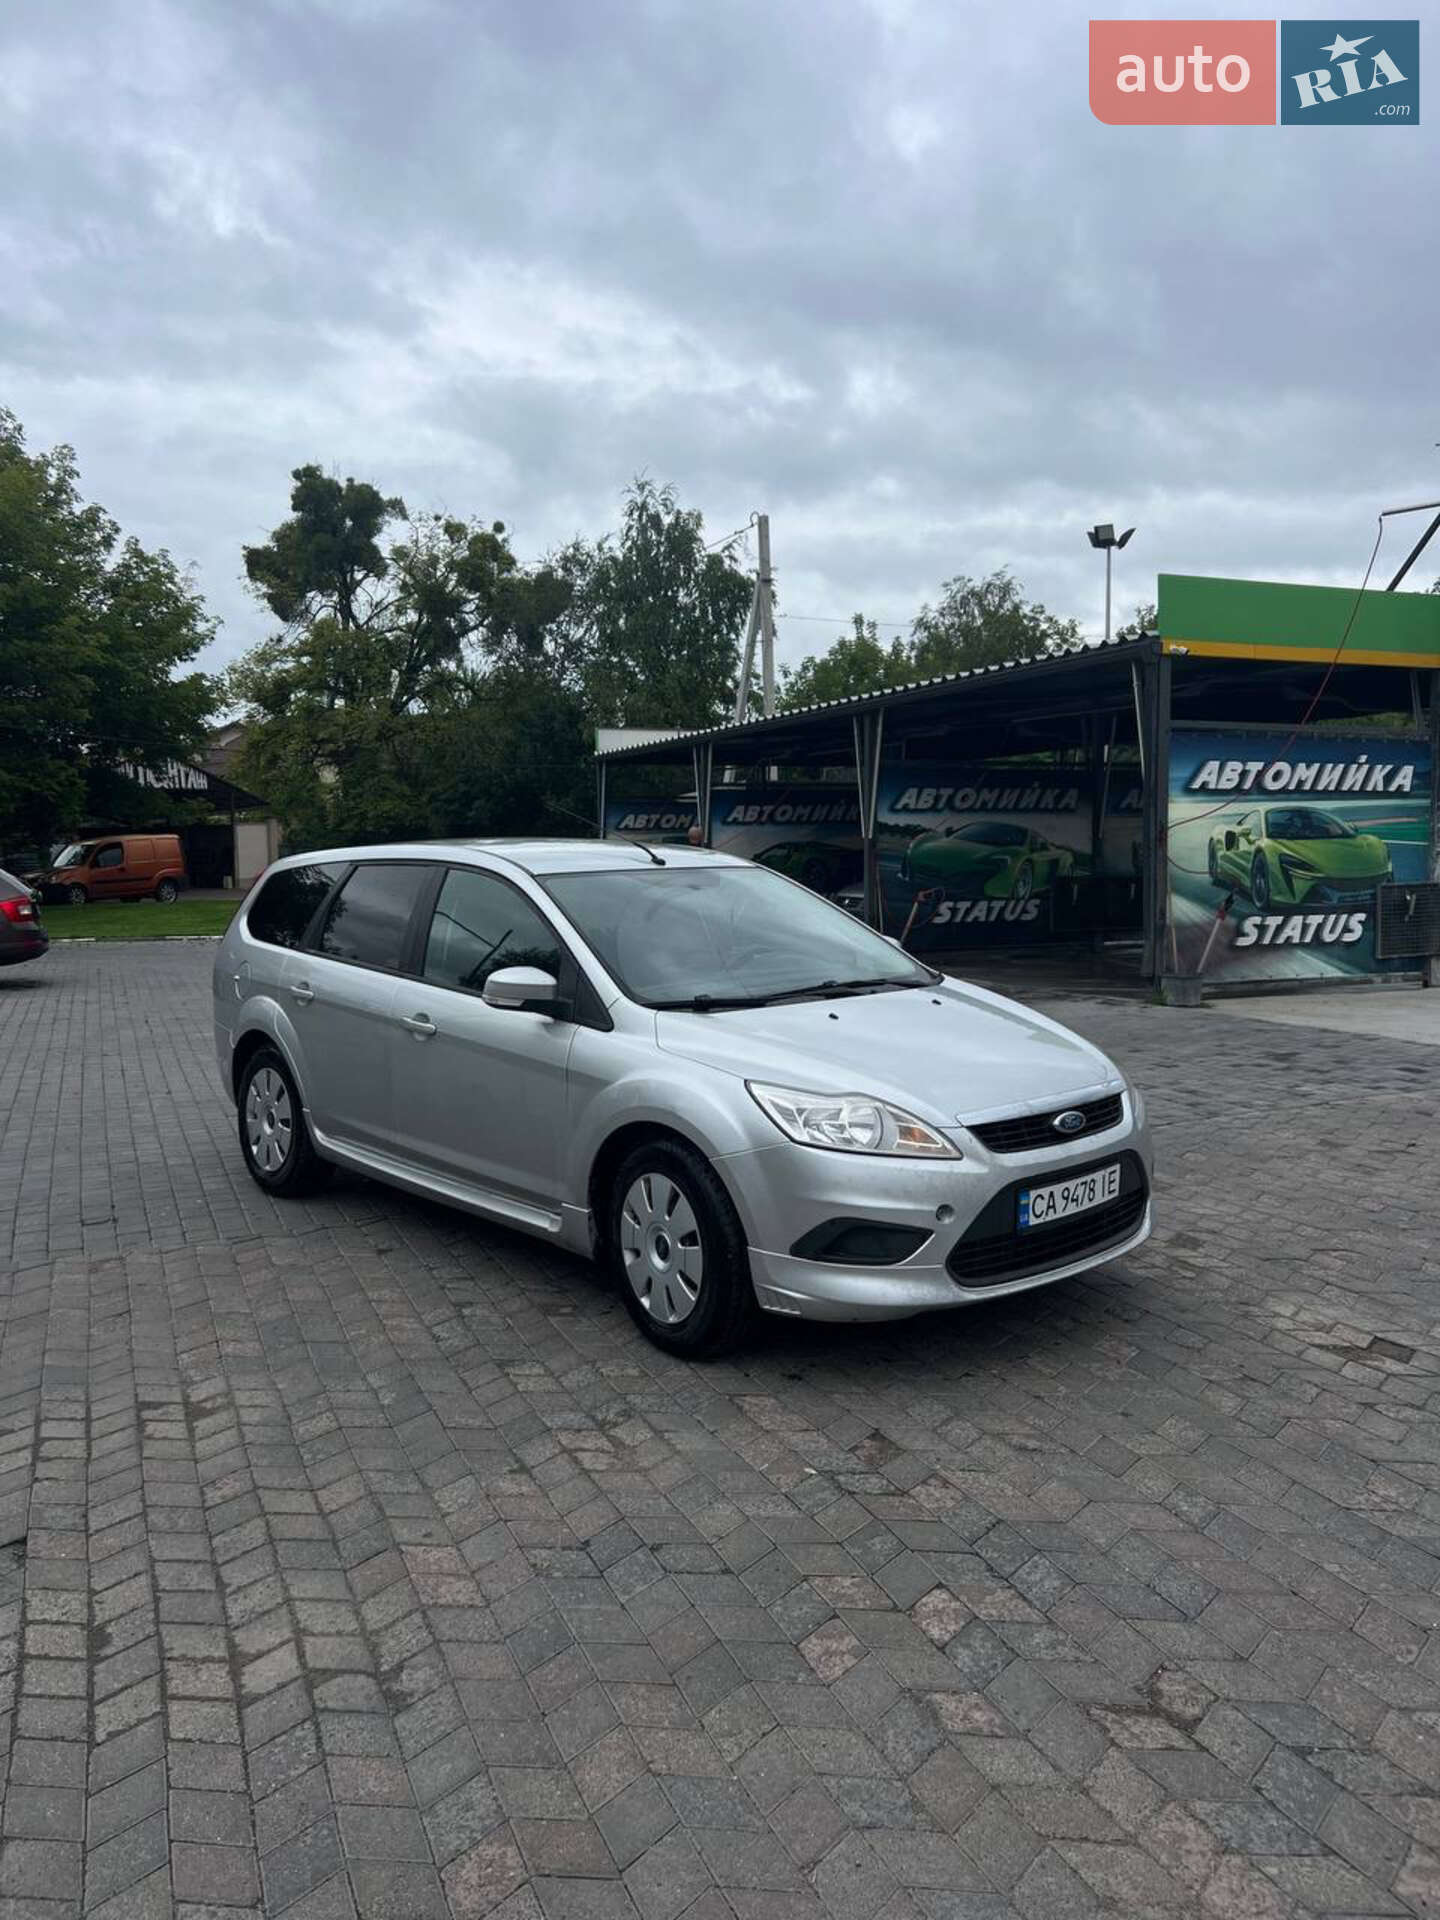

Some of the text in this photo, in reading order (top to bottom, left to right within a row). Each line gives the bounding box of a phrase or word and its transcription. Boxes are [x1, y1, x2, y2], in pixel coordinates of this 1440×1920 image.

[1190, 755, 1414, 792] АВТОМИЙКА
[894, 782, 1079, 810] АВТОМИЙКА
[932, 898, 1041, 924] STATUS
[1236, 912, 1367, 946] STATUS
[1031, 1169, 1117, 1219] CA 9478 IE
